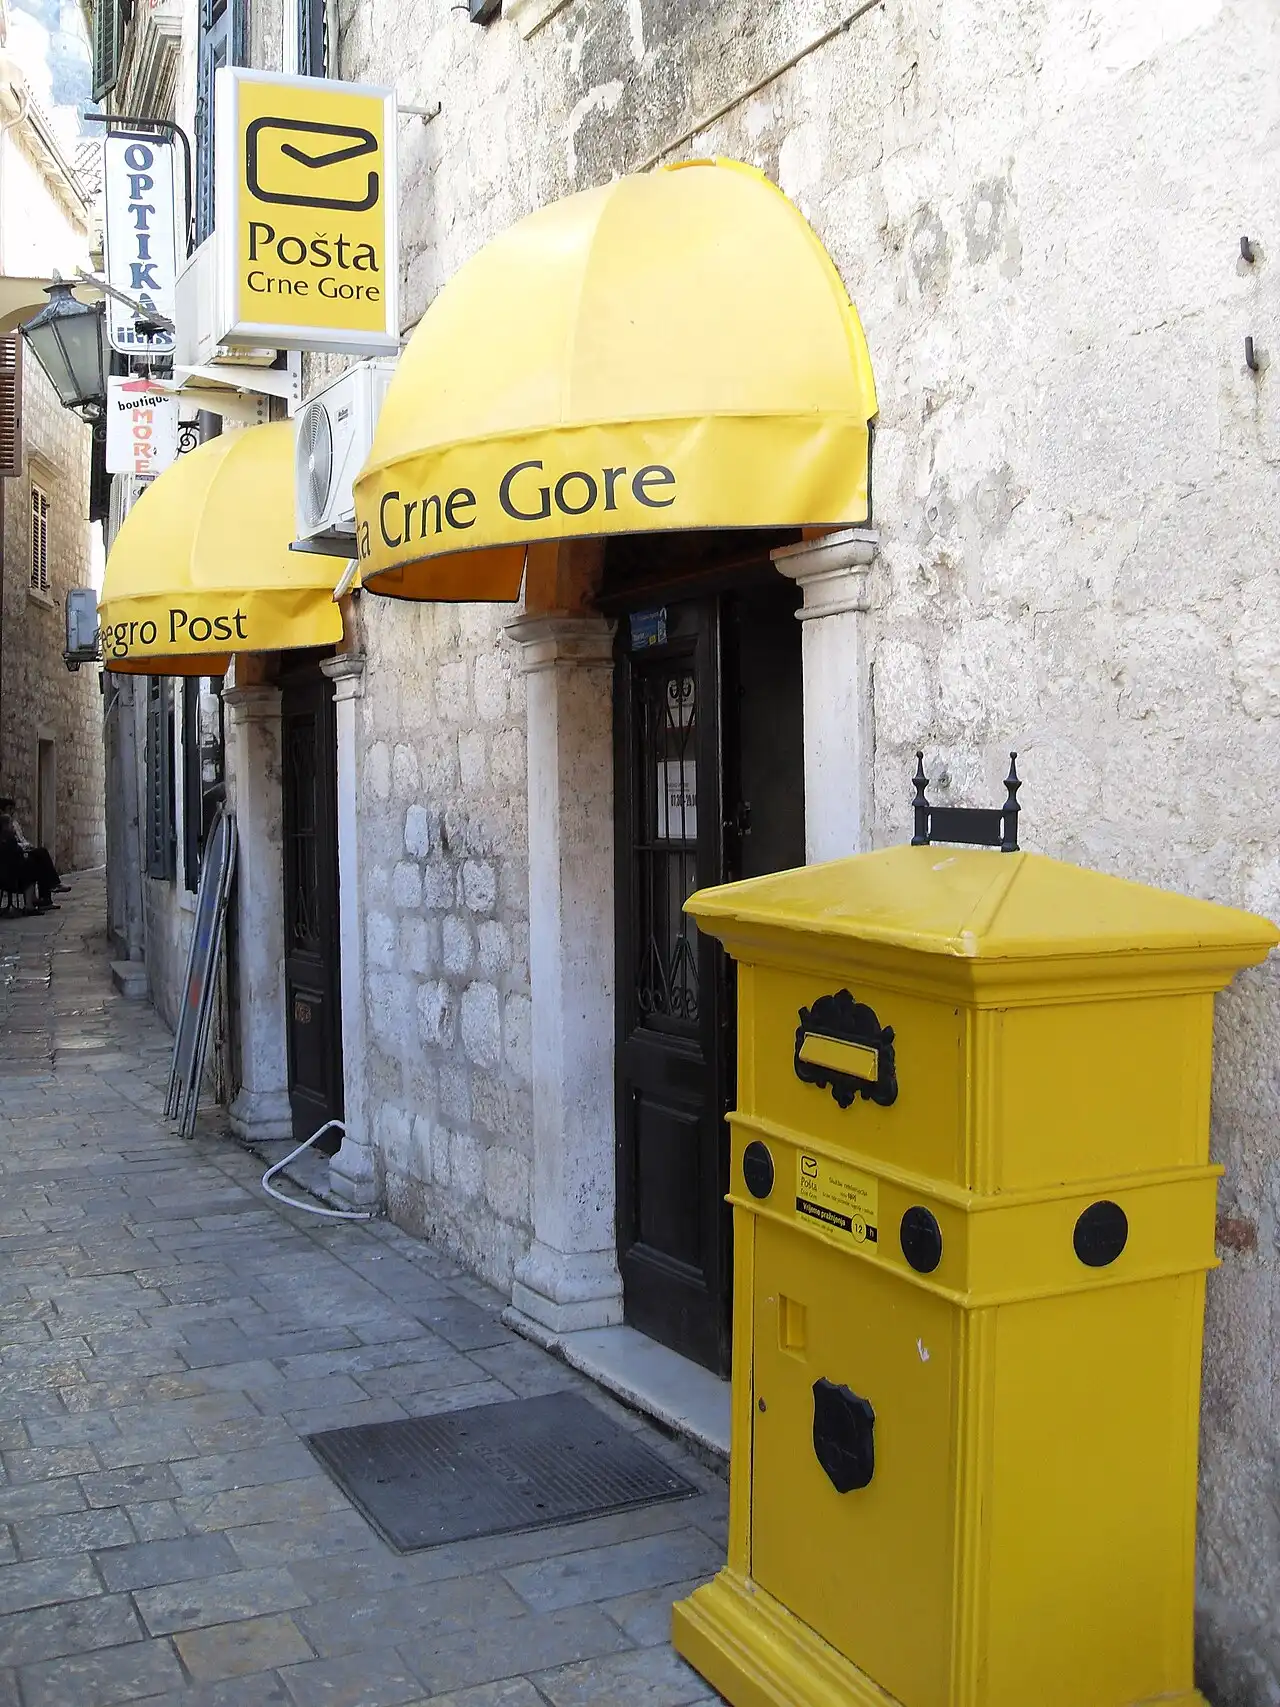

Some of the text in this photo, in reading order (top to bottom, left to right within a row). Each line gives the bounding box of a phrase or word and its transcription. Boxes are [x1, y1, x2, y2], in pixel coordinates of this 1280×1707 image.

[124, 143, 162, 319] OPTIKA
[247, 221, 379, 272] Pošta
[247, 271, 380, 301] Crne Gore
[132, 409, 154, 474] MORE
[379, 487, 478, 548] Crne
[499, 460, 677, 521] Gore
[169, 608, 249, 643] Post
[854, 1223, 863, 1234] 12
